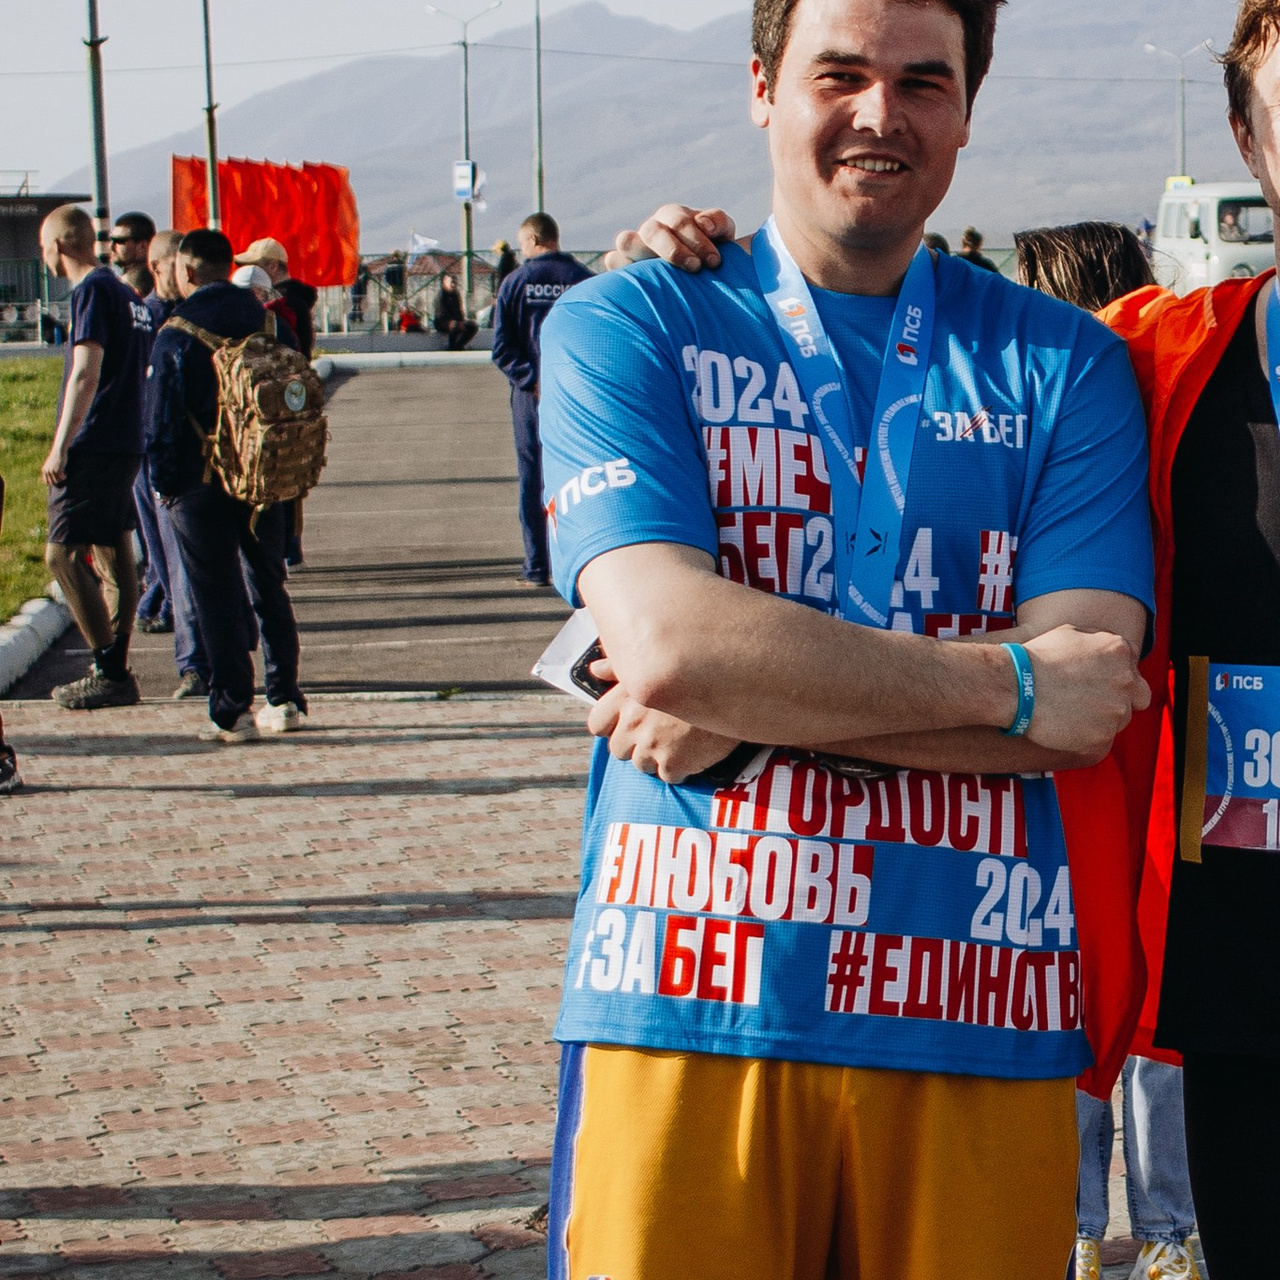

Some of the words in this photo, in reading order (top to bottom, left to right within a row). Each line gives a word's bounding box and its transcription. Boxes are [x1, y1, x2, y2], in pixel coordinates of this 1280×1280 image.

[526, 283, 574, 298] РОСС
[789, 319, 819, 359] ПСБ
[902, 304, 922, 343] ПСБ
[560, 457, 637, 516] ПСБ
[1232, 675, 1264, 691] ПСБ
[709, 752, 1029, 858] #ГОРДОСТ
[596, 822, 875, 927] #ЛЮБОВЬ
[825, 929, 1086, 1032] #ЕДИНСТВ
